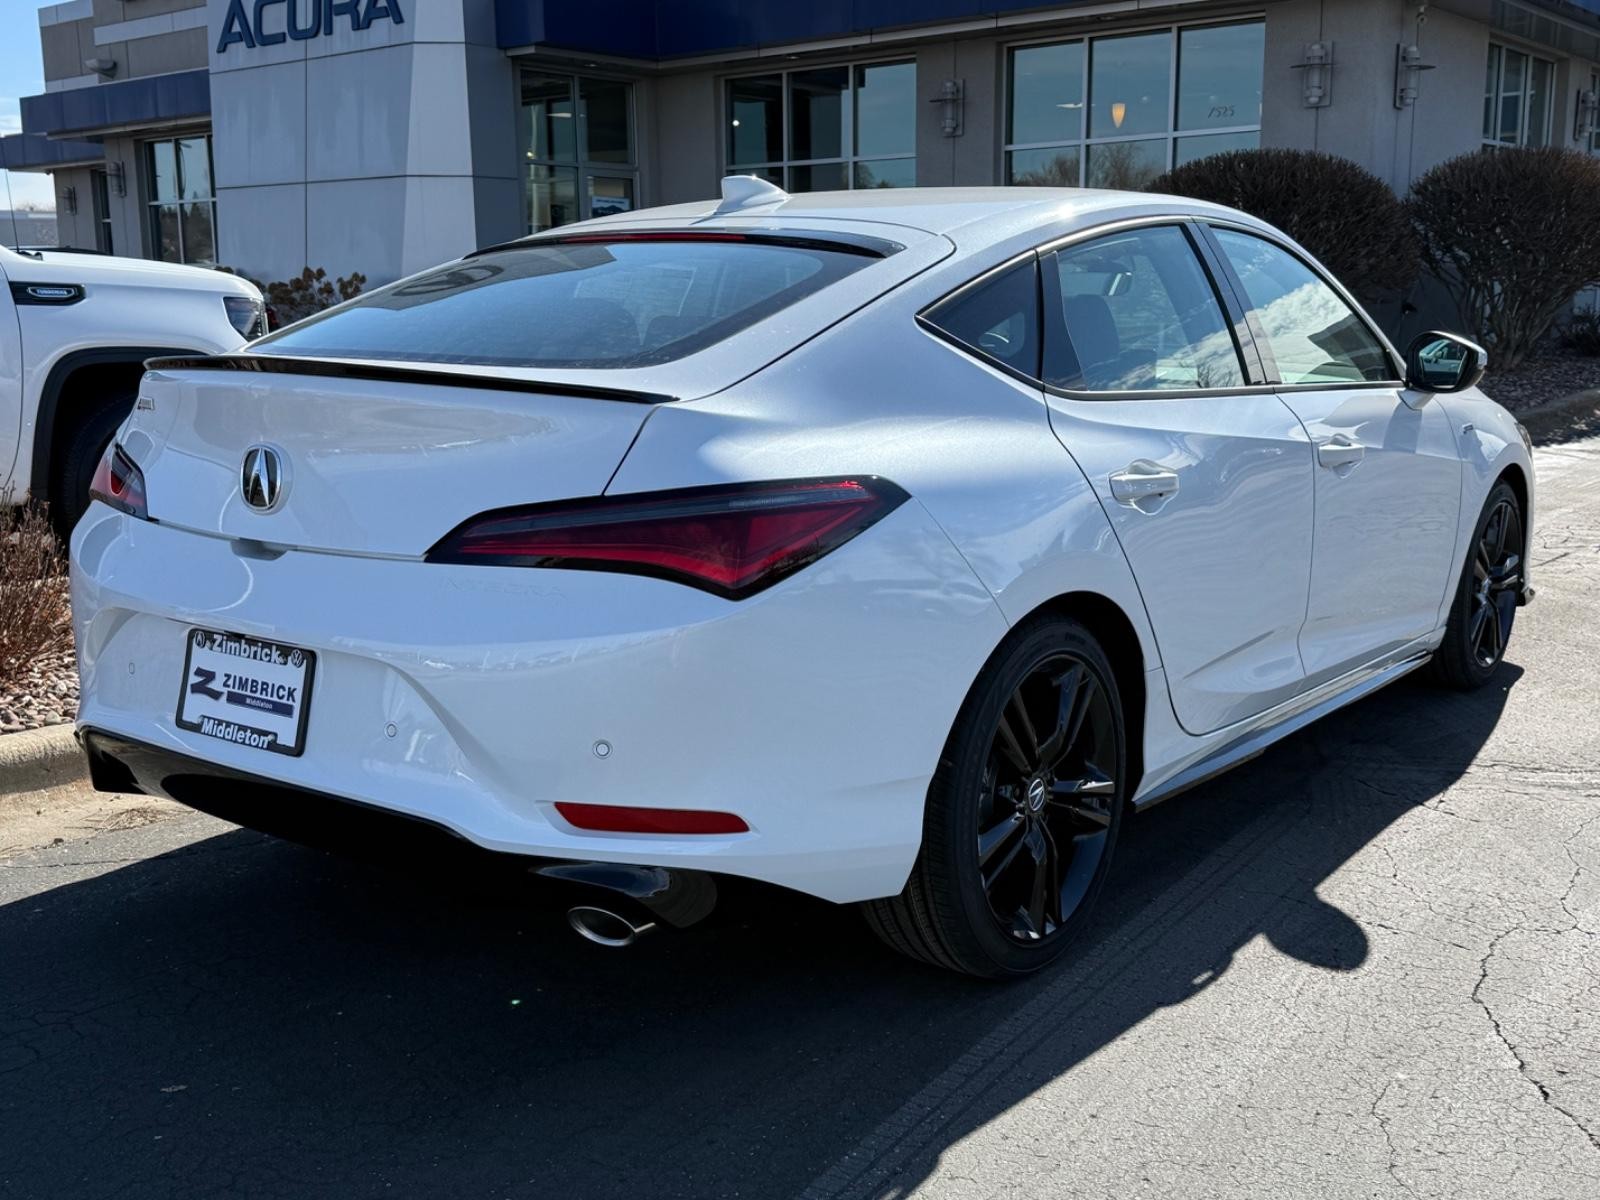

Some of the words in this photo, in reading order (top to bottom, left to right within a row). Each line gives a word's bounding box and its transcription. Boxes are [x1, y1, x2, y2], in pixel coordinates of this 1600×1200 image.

[216, 0, 404, 53] ACURA
[213, 634, 280, 664] Zimbrick
[223, 674, 297, 702] ZIMBRICK
[201, 718, 269, 748] Middleton
